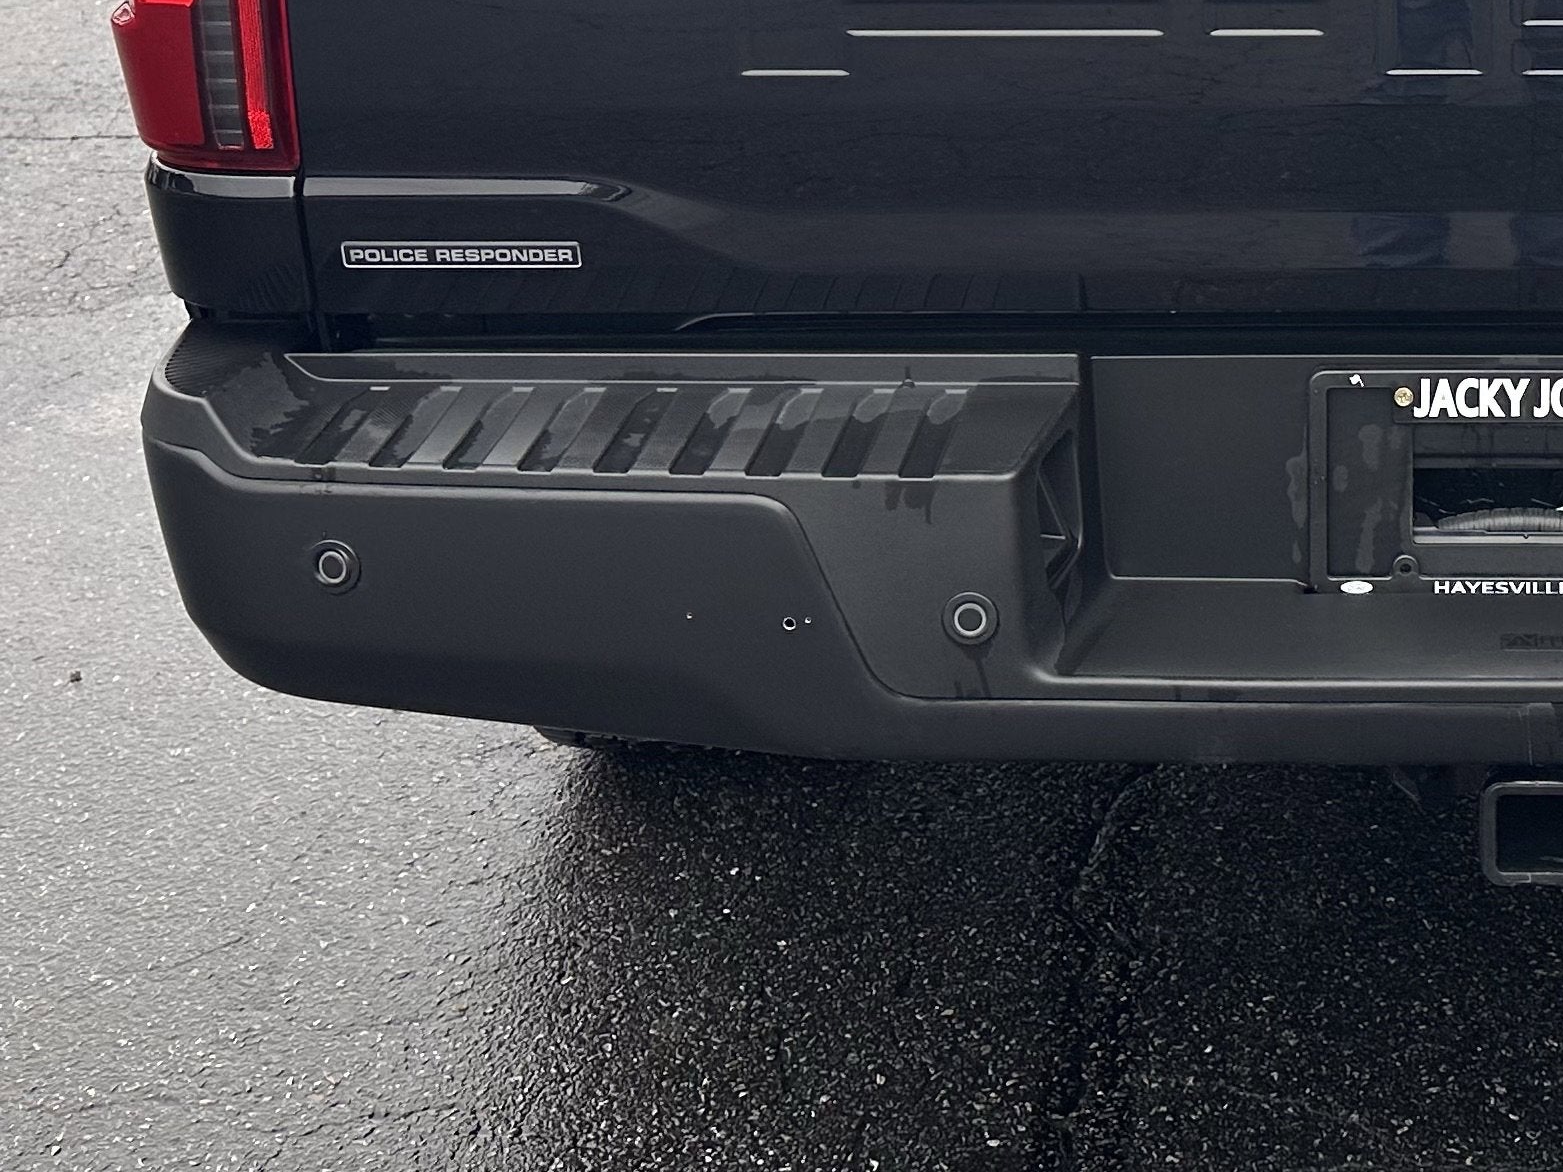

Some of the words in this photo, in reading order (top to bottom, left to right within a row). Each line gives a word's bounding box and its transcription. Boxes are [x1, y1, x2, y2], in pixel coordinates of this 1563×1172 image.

[349, 248, 429, 262] POLICE
[435, 248, 574, 262] RESPONDER
[1413, 377, 1530, 418] JACKY
